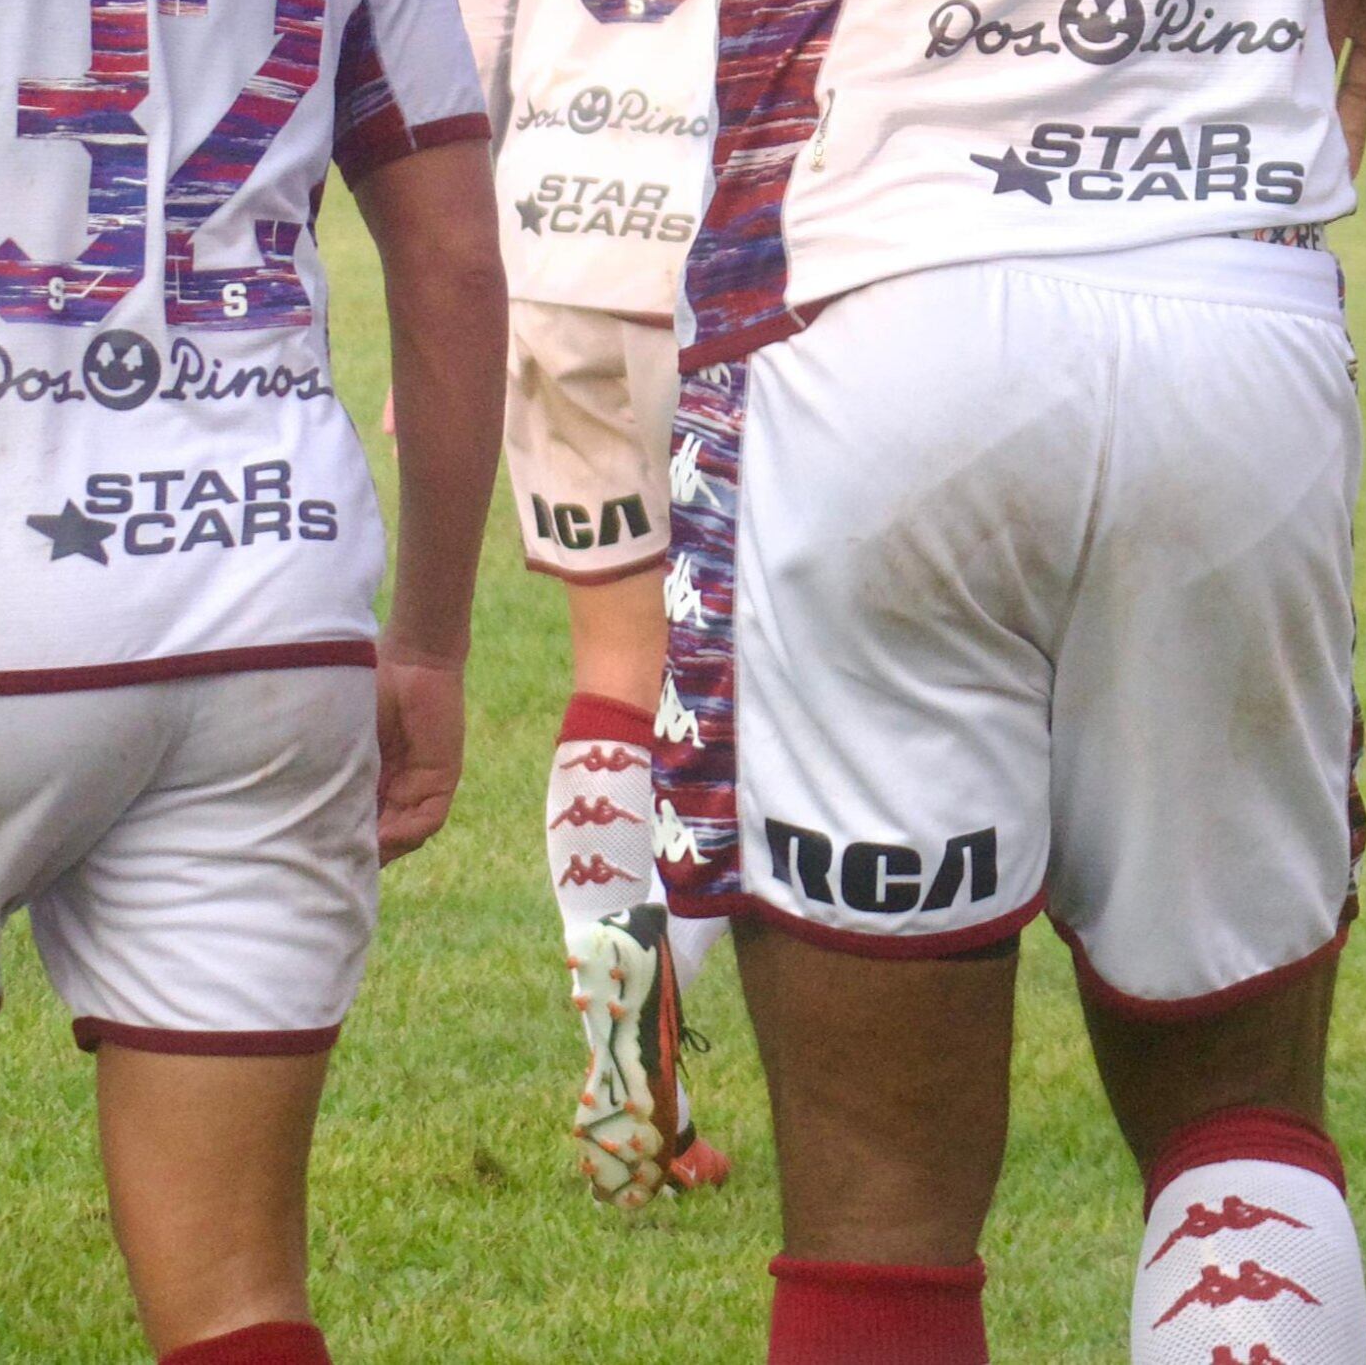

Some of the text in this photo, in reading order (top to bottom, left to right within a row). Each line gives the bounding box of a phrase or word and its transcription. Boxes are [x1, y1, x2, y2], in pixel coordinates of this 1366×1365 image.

[1024, 122, 1252, 172] STAR
[536, 173, 671, 211] STAR
[1067, 160, 1306, 205] CARS
[549, 203, 697, 243] CARS
[159, 336, 334, 401] Pinos
[84, 459, 292, 515] STAR
[123, 500, 338, 557] CARS
[764, 816, 999, 914] RCA
